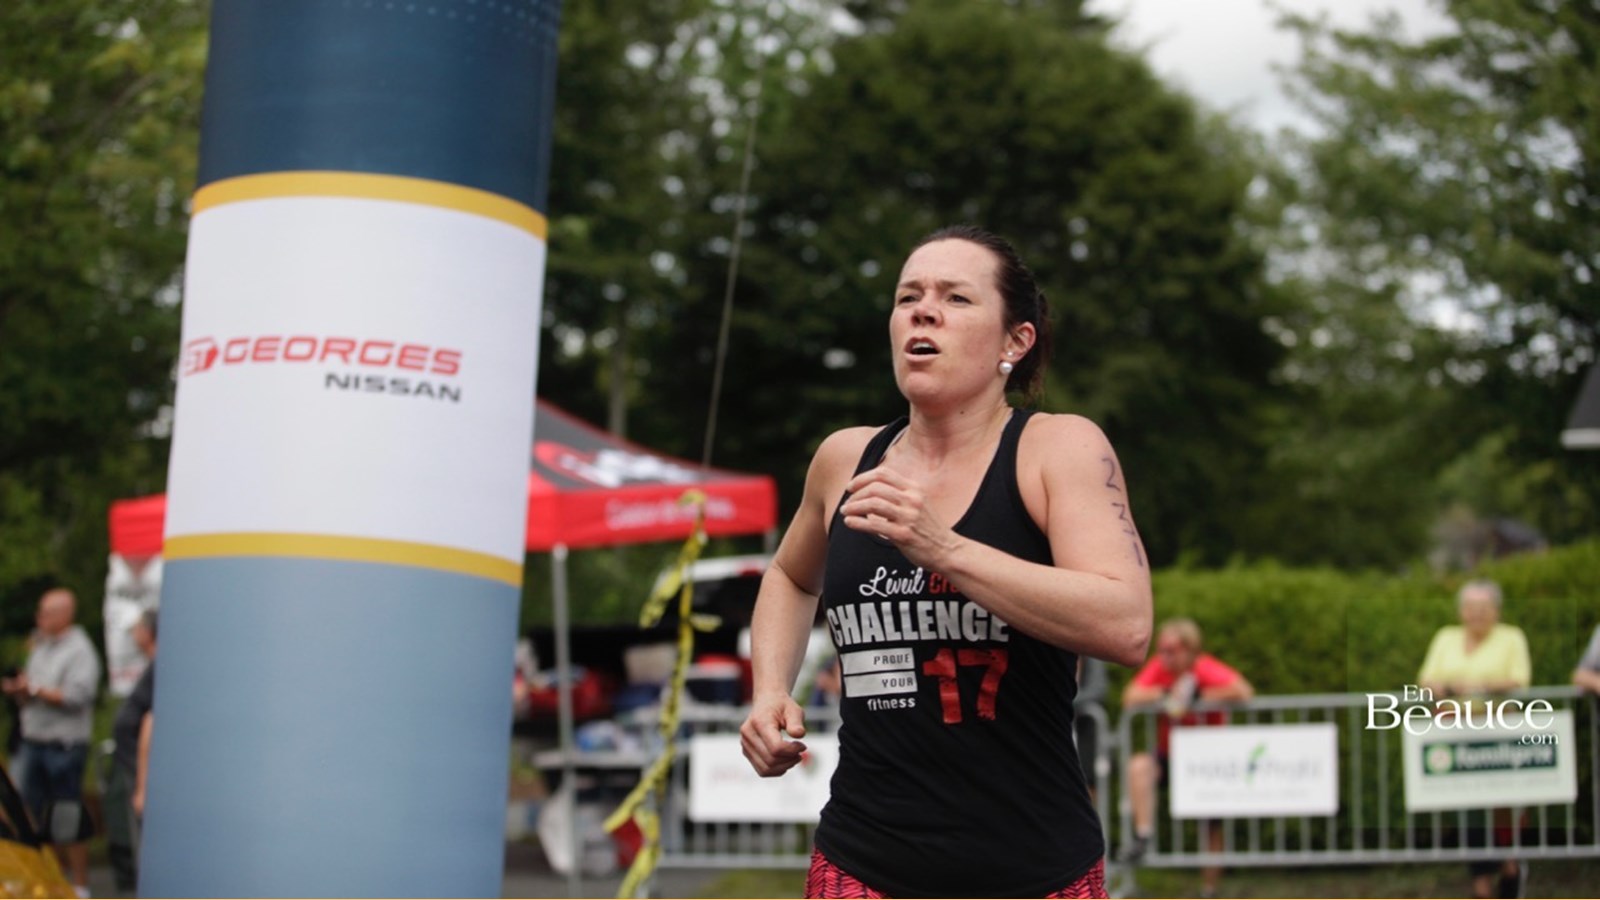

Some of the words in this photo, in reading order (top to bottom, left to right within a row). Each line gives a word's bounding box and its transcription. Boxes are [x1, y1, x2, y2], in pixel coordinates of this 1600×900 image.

[223, 336, 462, 375] GEORGES
[325, 373, 462, 403] NISSAN
[826, 600, 1009, 647] CHALLENGE
[882, 676, 914, 688] YOUR
[922, 647, 1009, 724] 17
[867, 697, 916, 711] fitness
